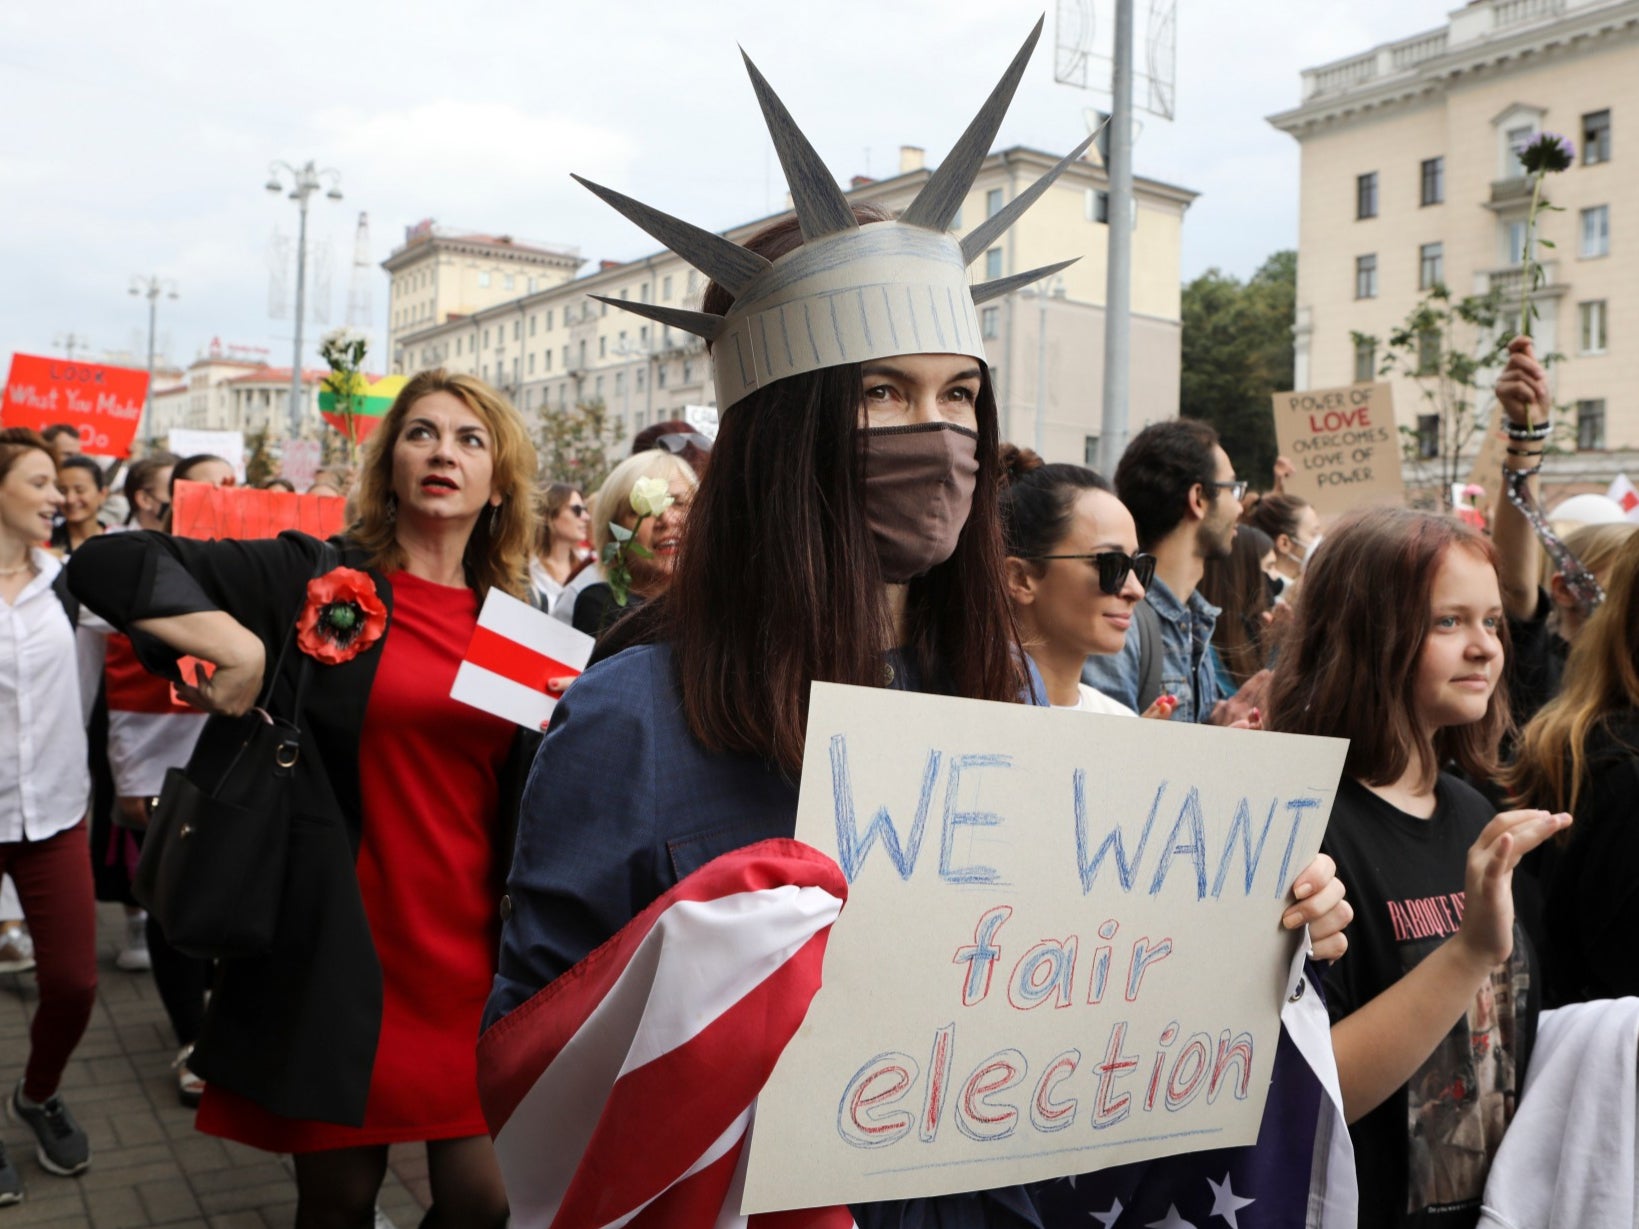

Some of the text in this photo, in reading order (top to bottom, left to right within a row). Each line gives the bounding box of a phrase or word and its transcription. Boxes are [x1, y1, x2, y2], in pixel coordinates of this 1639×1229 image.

[50, 364, 105, 384] LOOK
[8, 384, 59, 411] What
[65, 388, 93, 414] You
[1289, 388, 1373, 412] POWER OF
[1309, 406, 1371, 434] LOVE
[1292, 427, 1389, 453] OVERCOMES
[1303, 447, 1373, 470] LOVE OF
[1317, 467, 1373, 489] POWER
[829, 733, 1322, 901] WE WANT
[1386, 895, 1460, 941] BAROQUE
[952, 905, 1172, 1010] fair
[836, 1020, 1253, 1149] election
